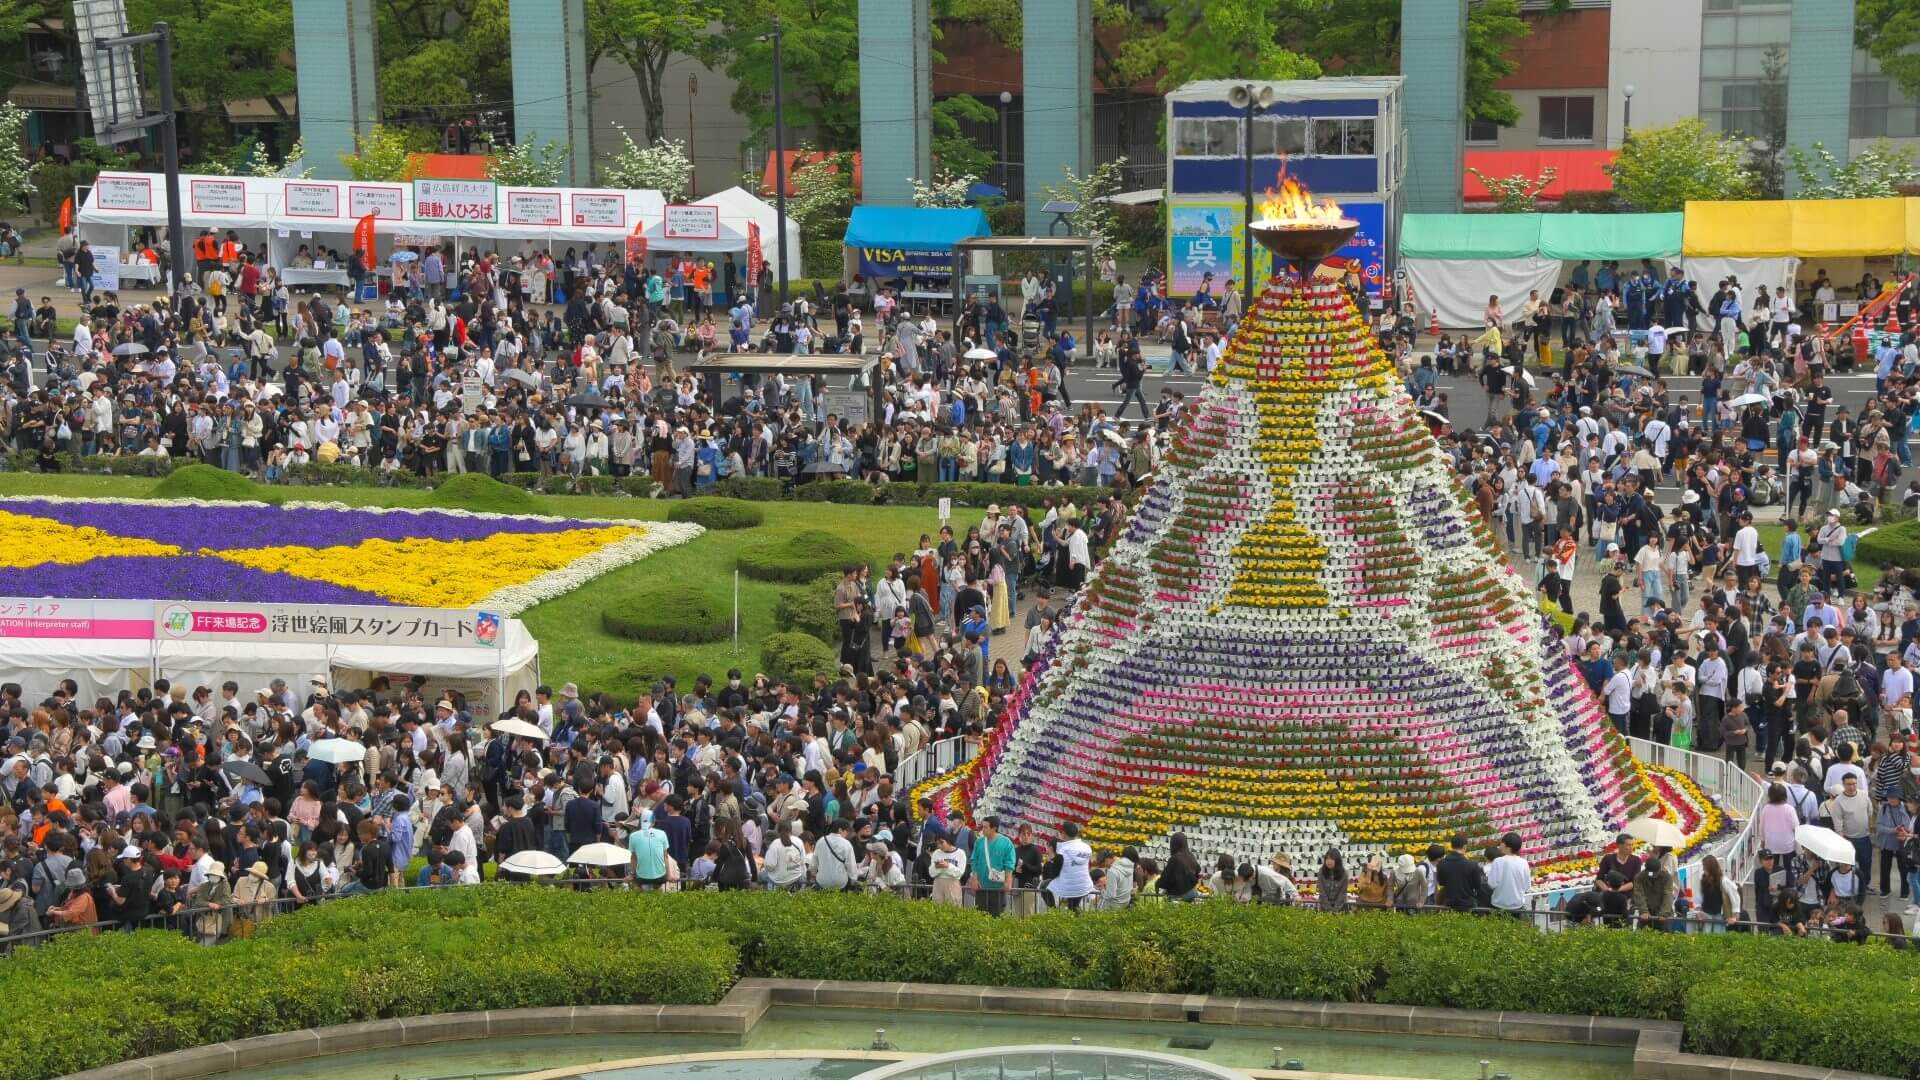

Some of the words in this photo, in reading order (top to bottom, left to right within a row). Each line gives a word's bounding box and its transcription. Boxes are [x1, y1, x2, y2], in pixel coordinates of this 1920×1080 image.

[418, 201, 493, 220] 興動人ひろば
[863, 247, 906, 263] VISA
[25, 620, 69, 629] (Interpreter
[197, 616, 261, 629] FF来場記念
[271, 614, 473, 638] 浮世絵風スタンプカード
